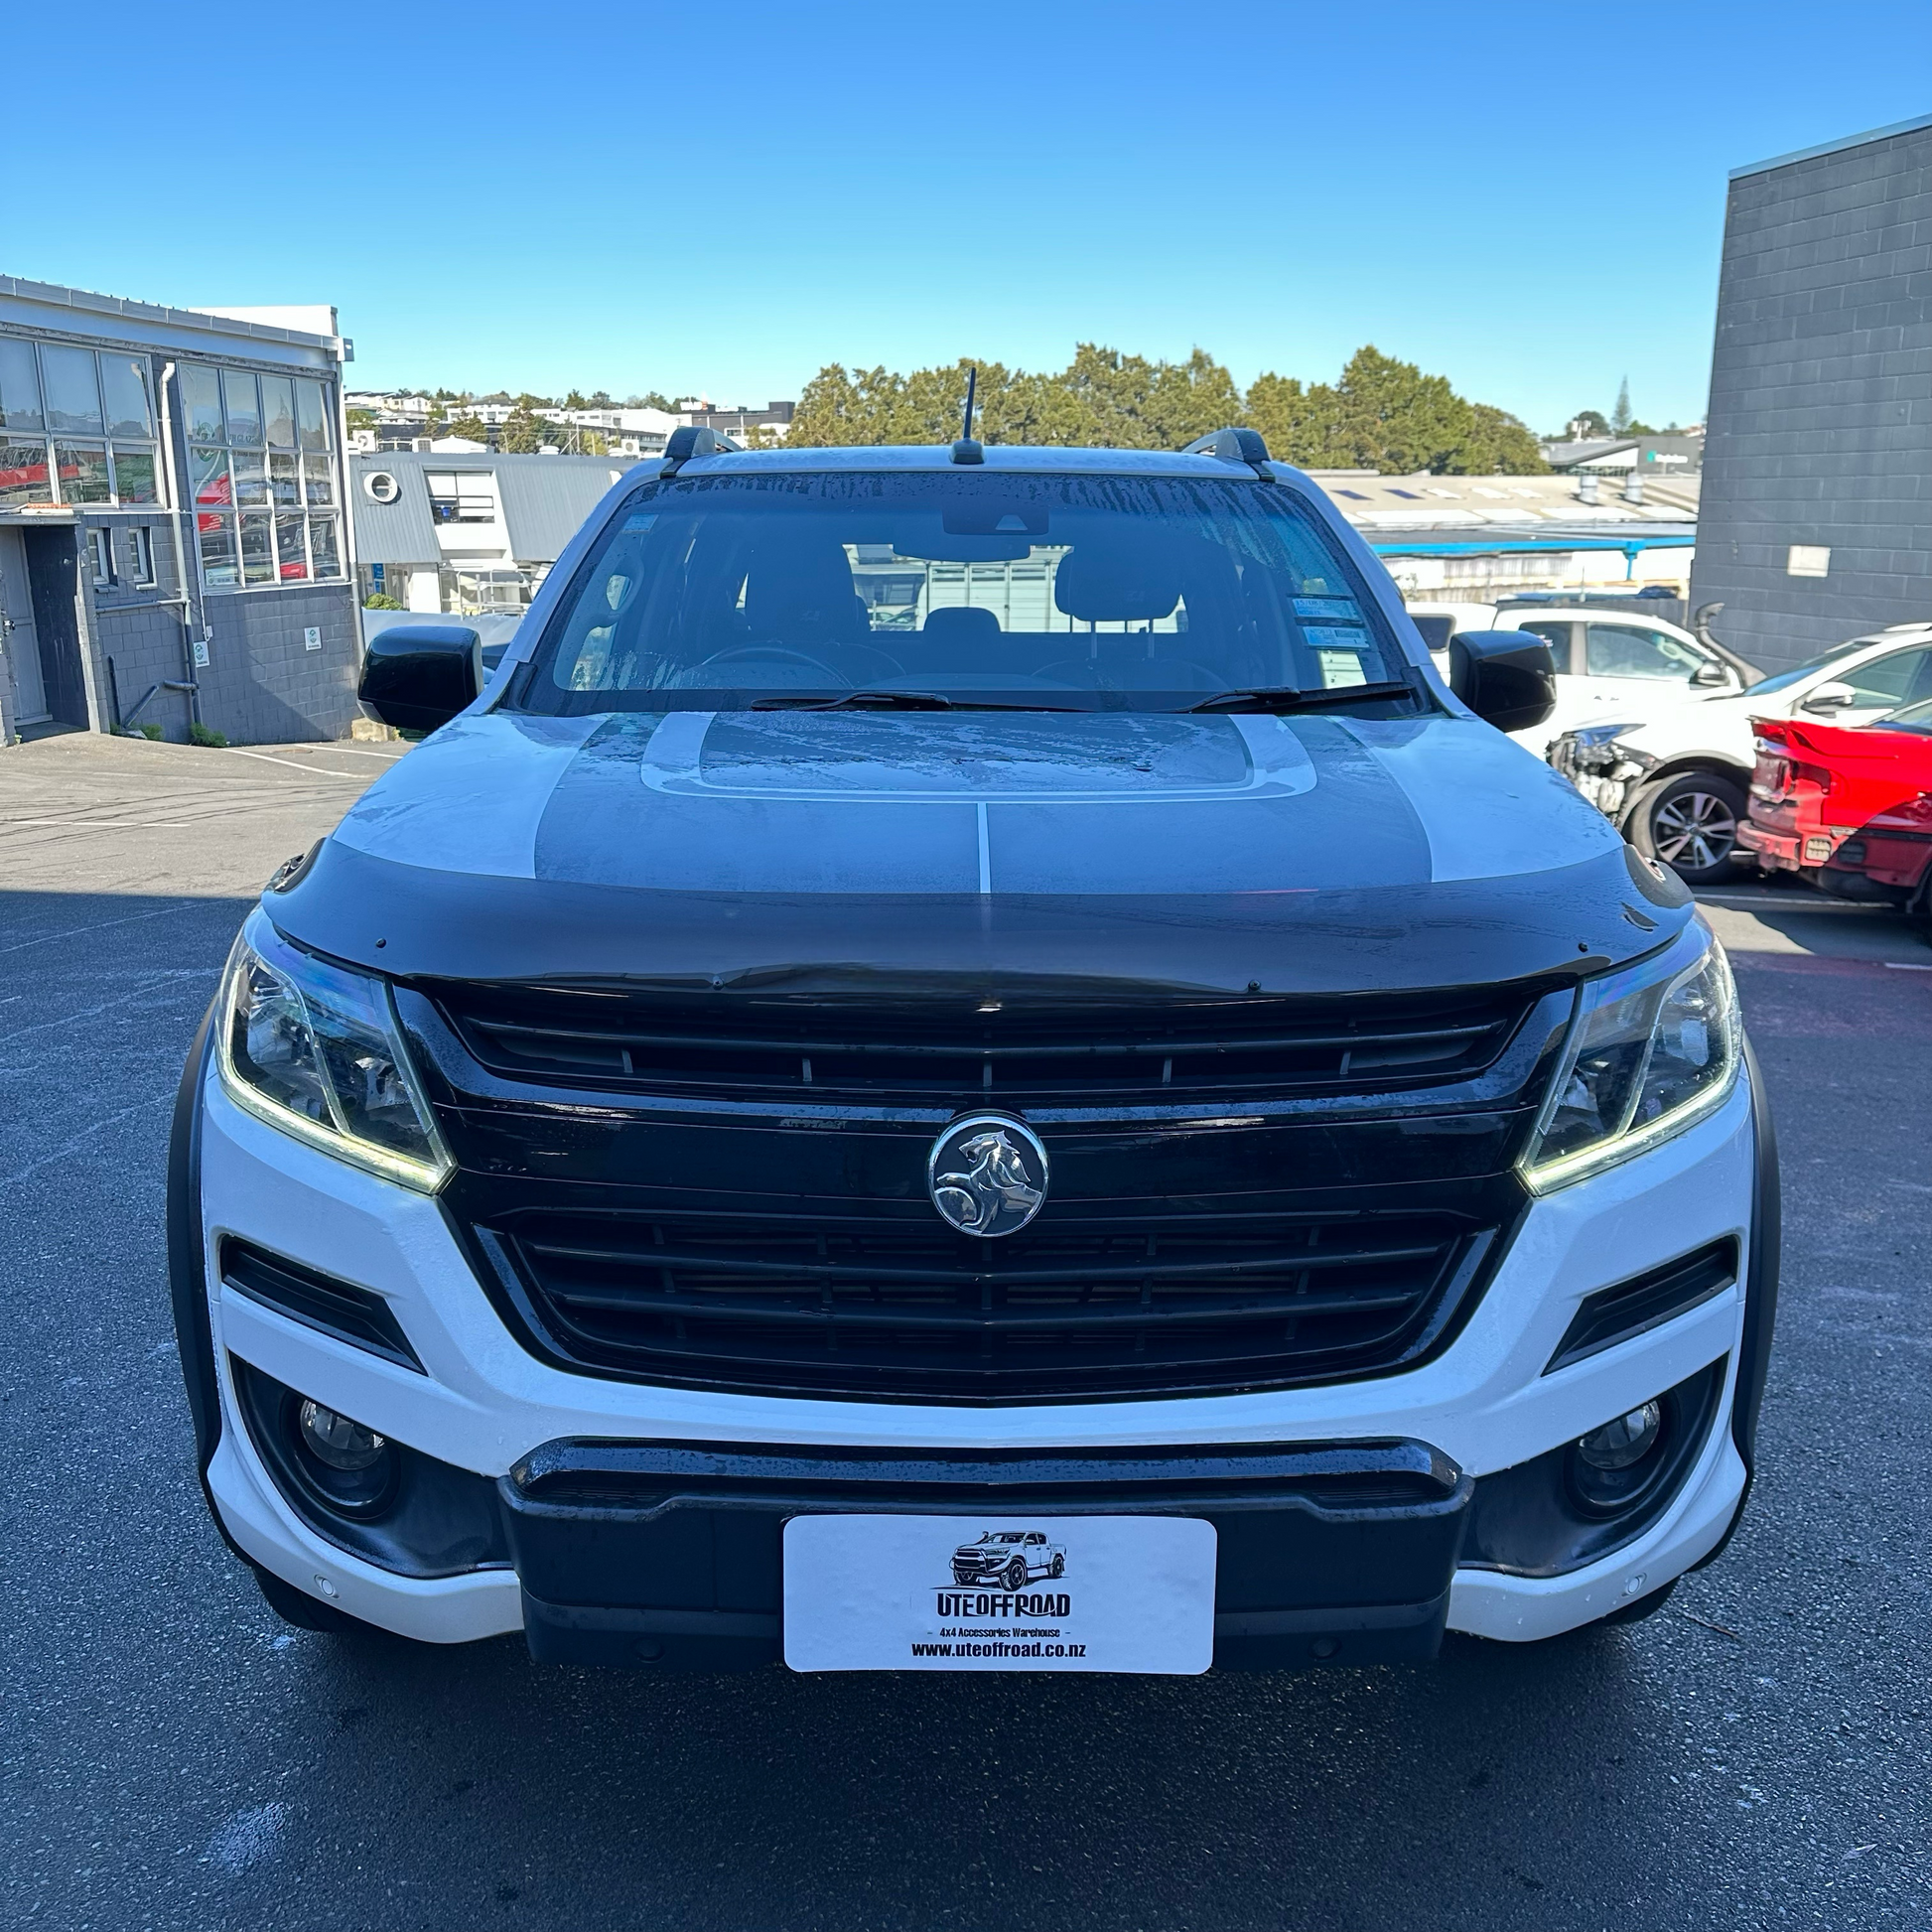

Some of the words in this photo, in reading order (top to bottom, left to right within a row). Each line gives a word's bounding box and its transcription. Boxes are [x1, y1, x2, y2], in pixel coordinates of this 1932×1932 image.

[937, 1592, 1070, 1617] UTEOFFROAD
[939, 1627, 956, 1637] 4x4
[958, 1627, 1011, 1638] Accessories
[1013, 1627, 1060, 1638] Warehouse
[911, 1641, 1087, 1658] www.uteoffroad.co.nz
